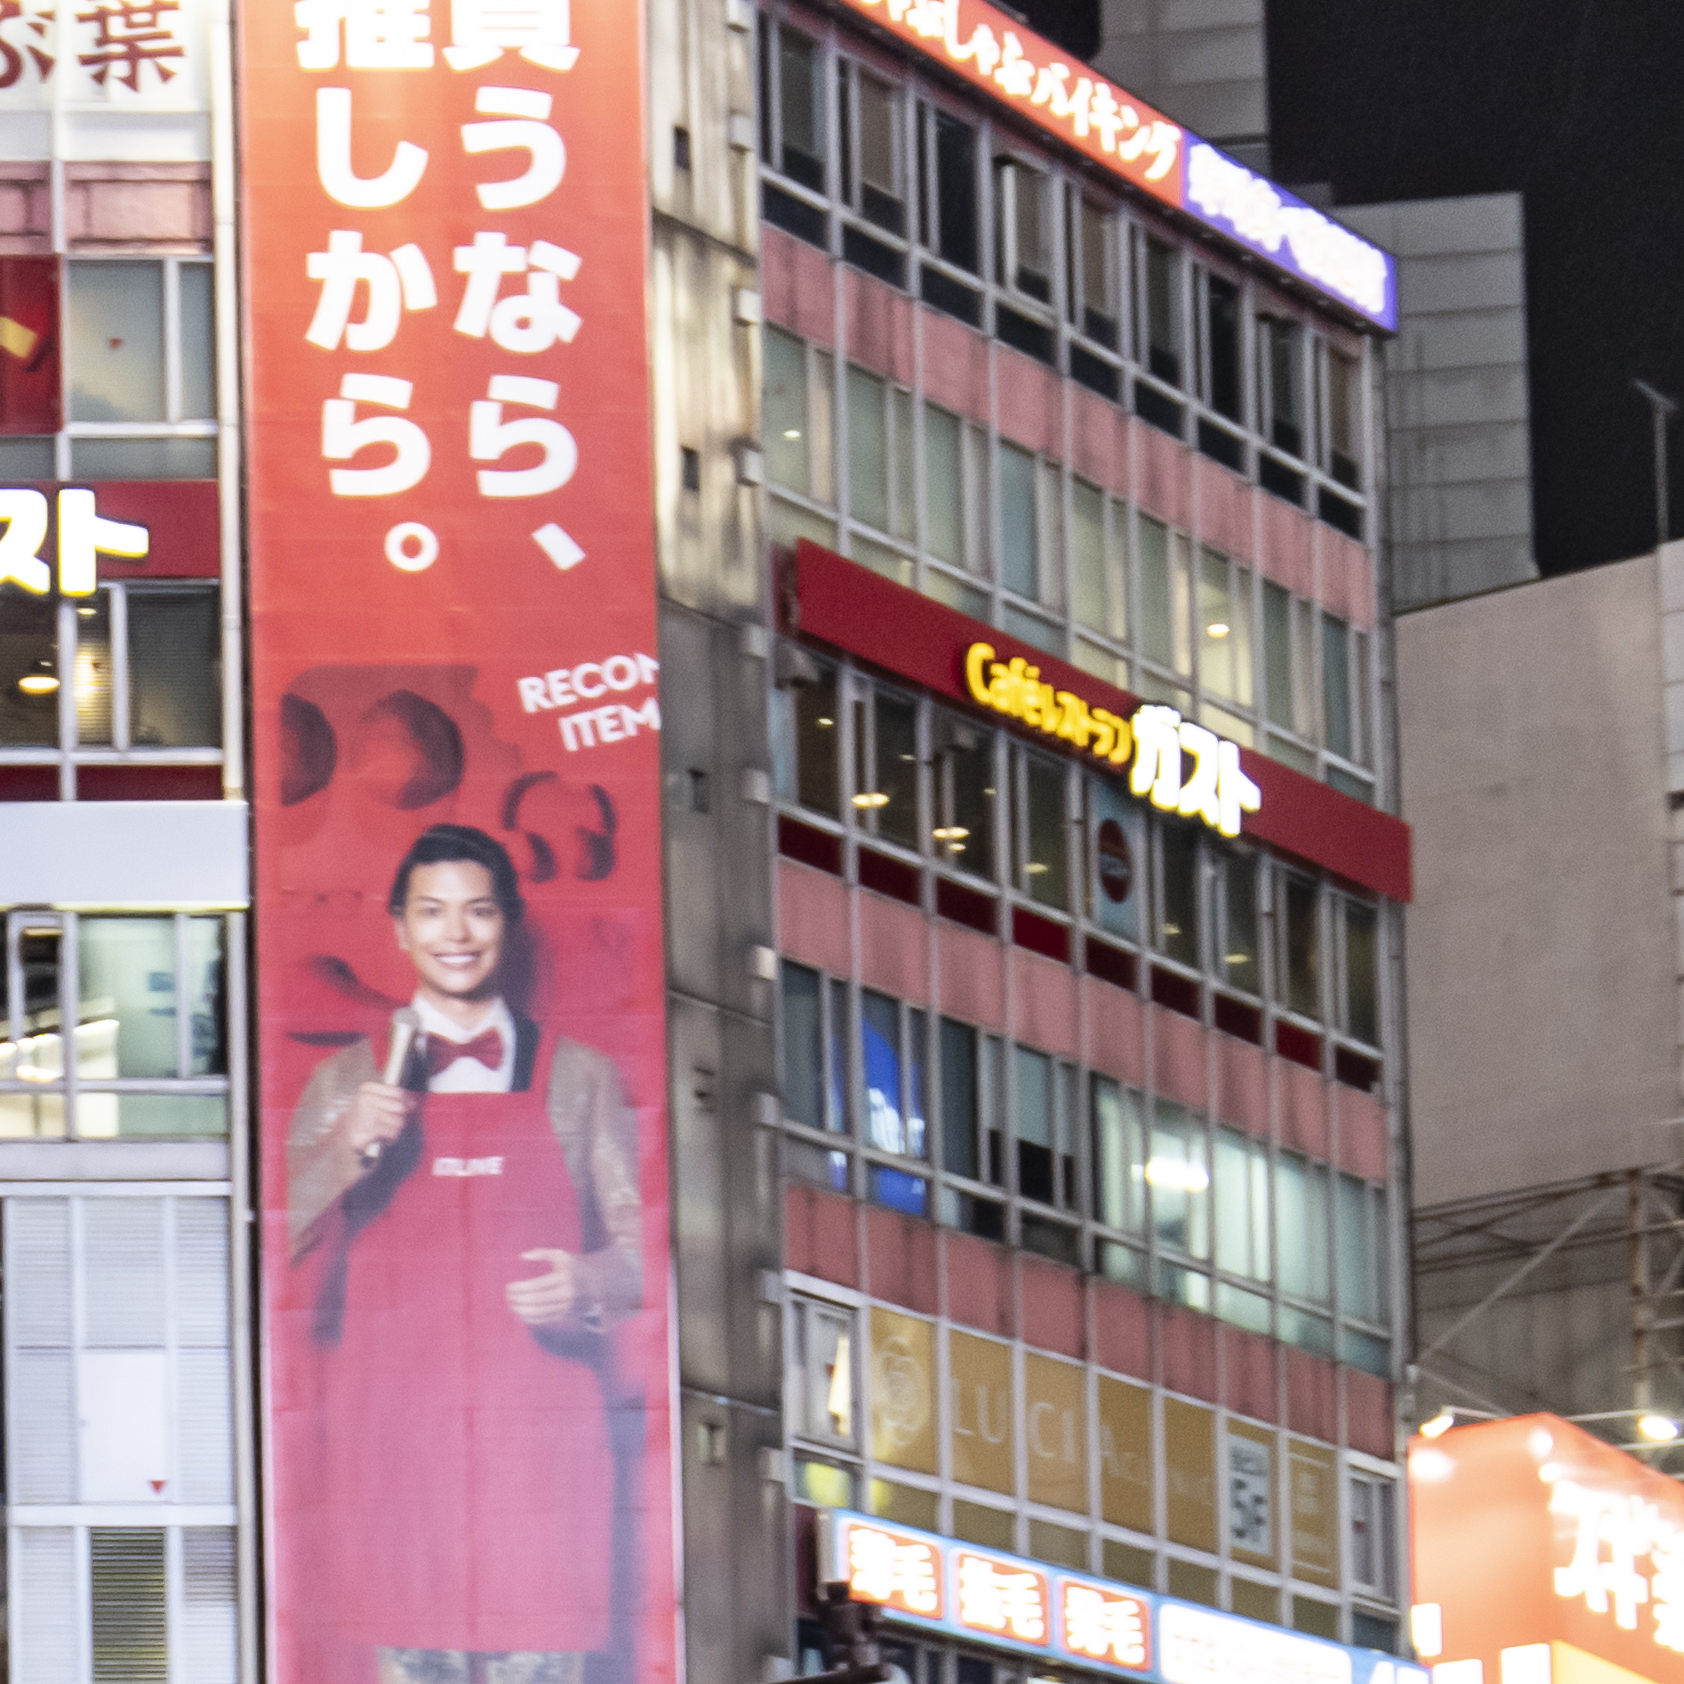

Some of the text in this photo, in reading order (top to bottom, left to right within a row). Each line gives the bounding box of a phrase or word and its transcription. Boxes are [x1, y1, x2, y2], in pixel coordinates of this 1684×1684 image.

[558, 697, 662, 752] ITEM
[1129, 705, 1261, 838] ガスト
